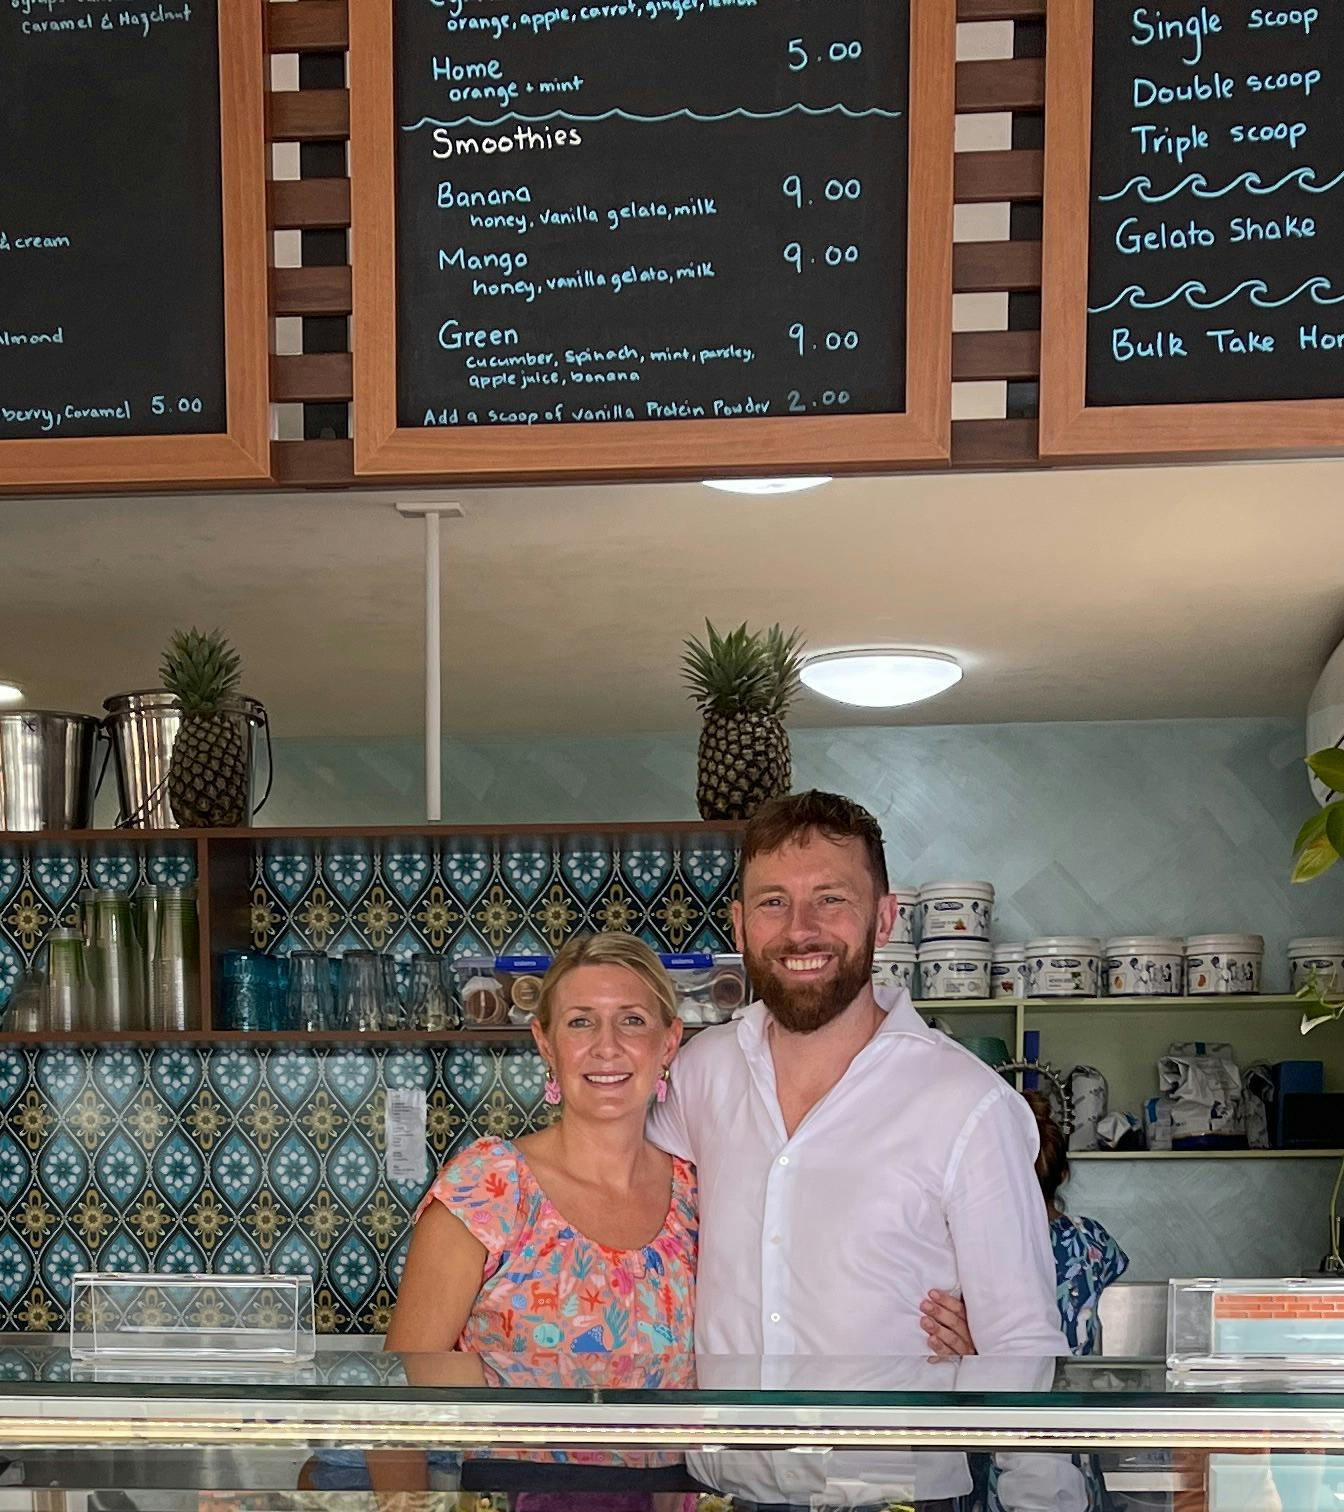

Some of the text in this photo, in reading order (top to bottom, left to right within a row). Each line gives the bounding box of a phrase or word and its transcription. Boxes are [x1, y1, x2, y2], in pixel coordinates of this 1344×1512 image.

[23, 19, 92, 33] Caramel
[120, 4, 191, 37] Hazelnut
[448, 14, 516, 39] orange,
[521, 8, 576, 33] apple,
[581, 0, 641, 19] carrot,
[1132, 7, 1318, 65] Single scoop
[433, 39, 861, 80] Home 5.00
[450, 82, 518, 107] orange
[540, 76, 583, 92] mint
[1134, 70, 1320, 107] Double scoop
[433, 126, 581, 158] Smoothies
[1132, 125, 1208, 163] Triple
[1231, 123, 1306, 148] scoop
[438, 176, 860, 208] Banana 9.00
[675, 198, 716, 215] milk
[15, 237, 69, 248] cream
[1116, 218, 1214, 253] Gelato
[1231, 216, 1315, 241] Shake
[440, 243, 858, 275] Mango 9.00
[474, 280, 541, 302] honey,
[547, 270, 606, 289] vanilla
[677, 262, 714, 278] milk
[439, 320, 858, 355] Green 9.00
[1113, 328, 1187, 360] Bulk
[1207, 330, 1274, 353] Take
[571, 372, 639, 382] banana
[152, 396, 201, 414] 5.00
[424, 409, 458, 425] Add
[467, 412, 477, 422] a
[488, 410, 538, 426] scoop
[545, 404, 563, 421] of
[788, 391, 849, 411] 2.00
